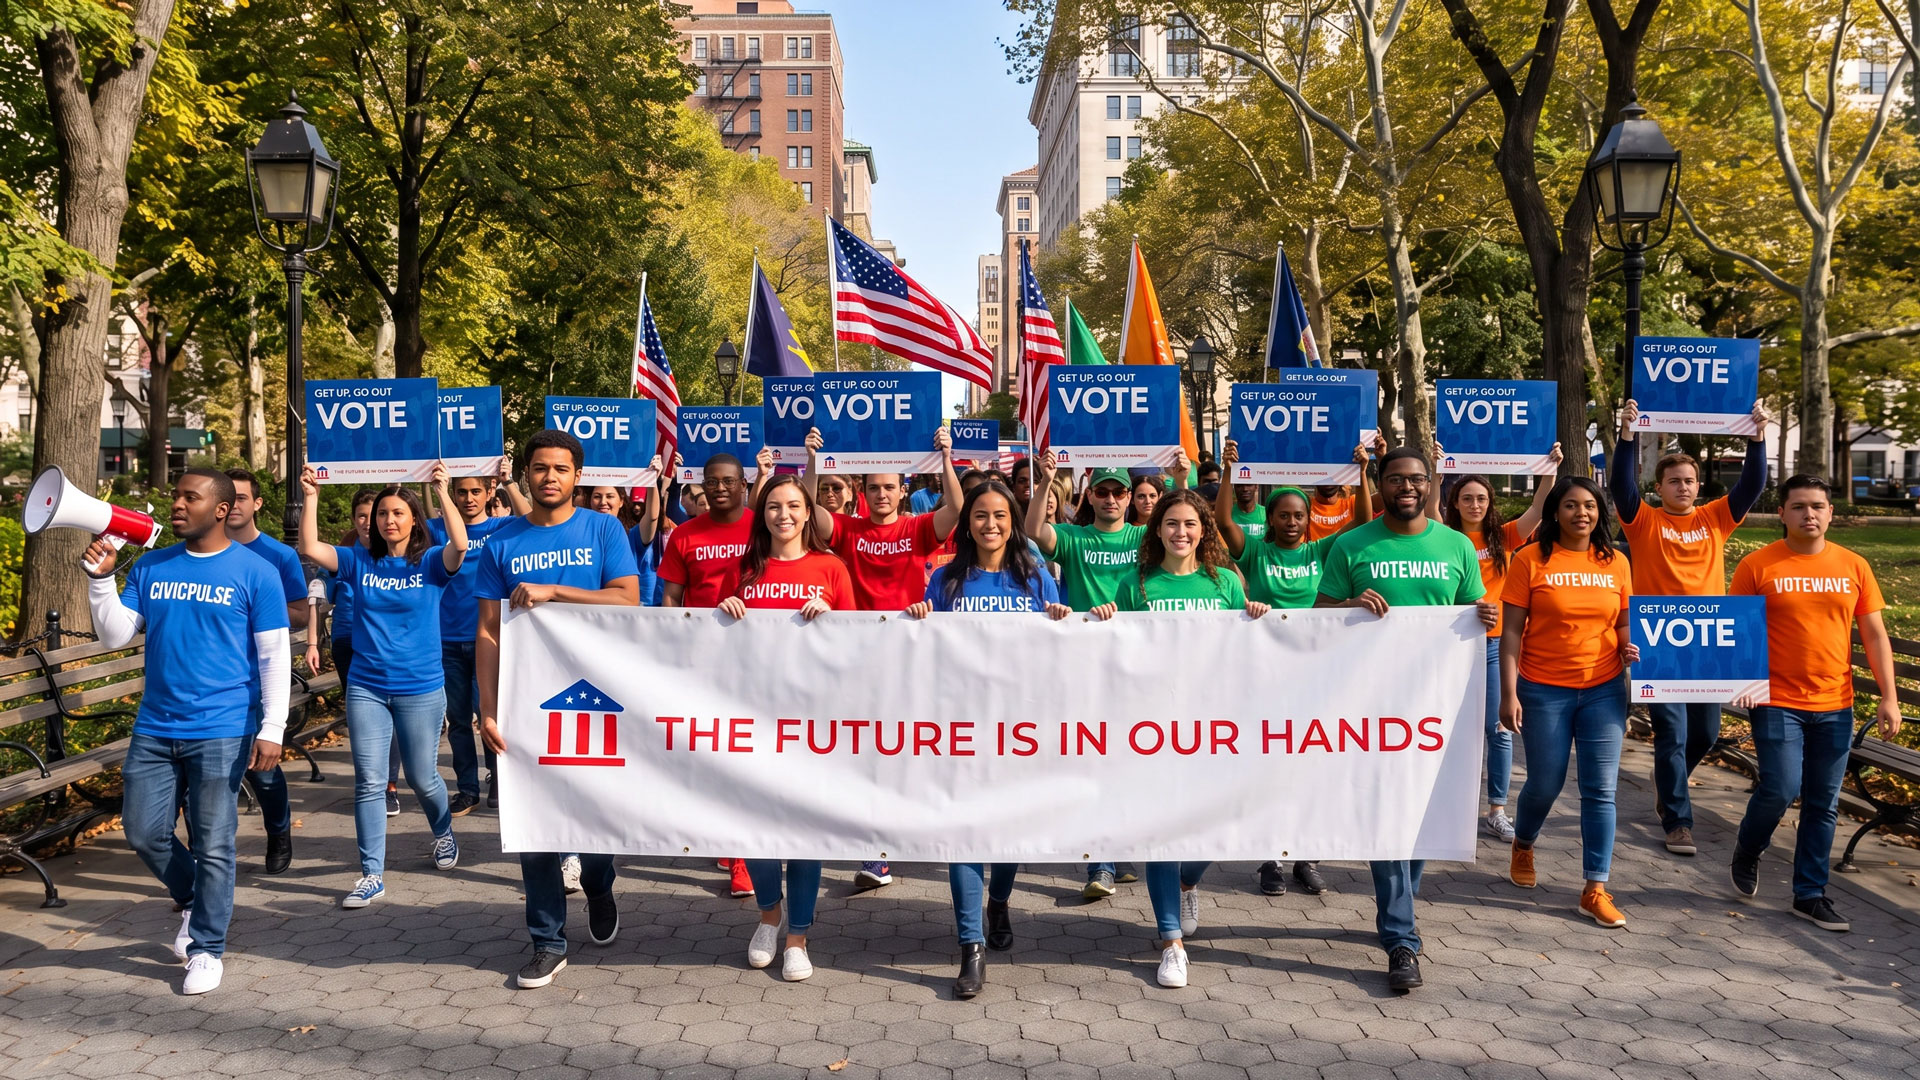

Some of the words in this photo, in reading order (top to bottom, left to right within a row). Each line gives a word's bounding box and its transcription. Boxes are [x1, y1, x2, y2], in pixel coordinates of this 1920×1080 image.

[1643, 345, 1661, 353] GET
[1664, 345, 1677, 354] UP,
[1679, 345, 1694, 353] GO
[1697, 346, 1717, 354] OUT
[1058, 374, 1077, 382] GET
[1080, 374, 1094, 383] UP,
[1097, 374, 1112, 382] GO
[1115, 373, 1136, 382] OUT
[1643, 357, 1729, 384] VOTE
[315, 389, 334, 398] GET
[336, 389, 351, 398] UP,
[354, 388, 370, 397] GO
[371, 387, 392, 396] OUT
[772, 384, 788, 392] GET
[790, 384, 803, 392] UP,
[823, 381, 841, 389] GET
[844, 381, 857, 390] UP,
[860, 380, 875, 389] GO
[878, 380, 899, 389] OUT
[1445, 388, 1463, 396] GET
[1465, 388, 1479, 396] UP,
[1481, 388, 1495, 396] GO
[1497, 388, 1516, 396] OUT
[444, 395, 463, 403] OUT
[1058, 387, 1149, 414] VOTE
[1241, 392, 1259, 400] GET
[1262, 392, 1276, 401] UP,
[1279, 392, 1294, 400] GO
[1296, 393, 1317, 401] OUT
[553, 404, 569, 412] GET
[571, 404, 583, 413] UP,
[601, 405, 620, 413] OUT
[823, 393, 912, 420] VOTE
[1446, 400, 1528, 425] VOTE
[316, 401, 407, 429] VOTE
[683, 412, 697, 420] GET
[698, 412, 709, 420] UP,
[1241, 405, 1329, 432] VOTE
[553, 415, 630, 440] VOTE
[684, 423, 750, 444] VOTE
[953, 427, 988, 440] VOTE
[511, 548, 592, 574] CIVICPULSE
[1085, 549, 1137, 565] VOTEWAVE
[1371, 561, 1449, 580] VOTEWAVE
[1545, 573, 1615, 588] VOTEWAVE
[1774, 577, 1851, 594] VOTEWAVE
[149, 581, 235, 606] CIVICPULSE
[744, 582, 824, 600] CIVICPULSE
[952, 596, 1033, 612] CIVICPULSE
[1147, 598, 1222, 611] VOTEWAVE
[1639, 605, 1660, 614] GET
[1663, 605, 1677, 614] UP,
[1679, 605, 1695, 614] GO
[1697, 605, 1720, 614] OUT
[1640, 618, 1736, 647] VOTE
[656, 717, 754, 752] THE
[776, 719, 976, 756] FUTURE
[997, 722, 1039, 756] IS
[1060, 722, 1107, 756] IN
[1128, 720, 1239, 756] OUR
[1261, 716, 1444, 754] HANDS
